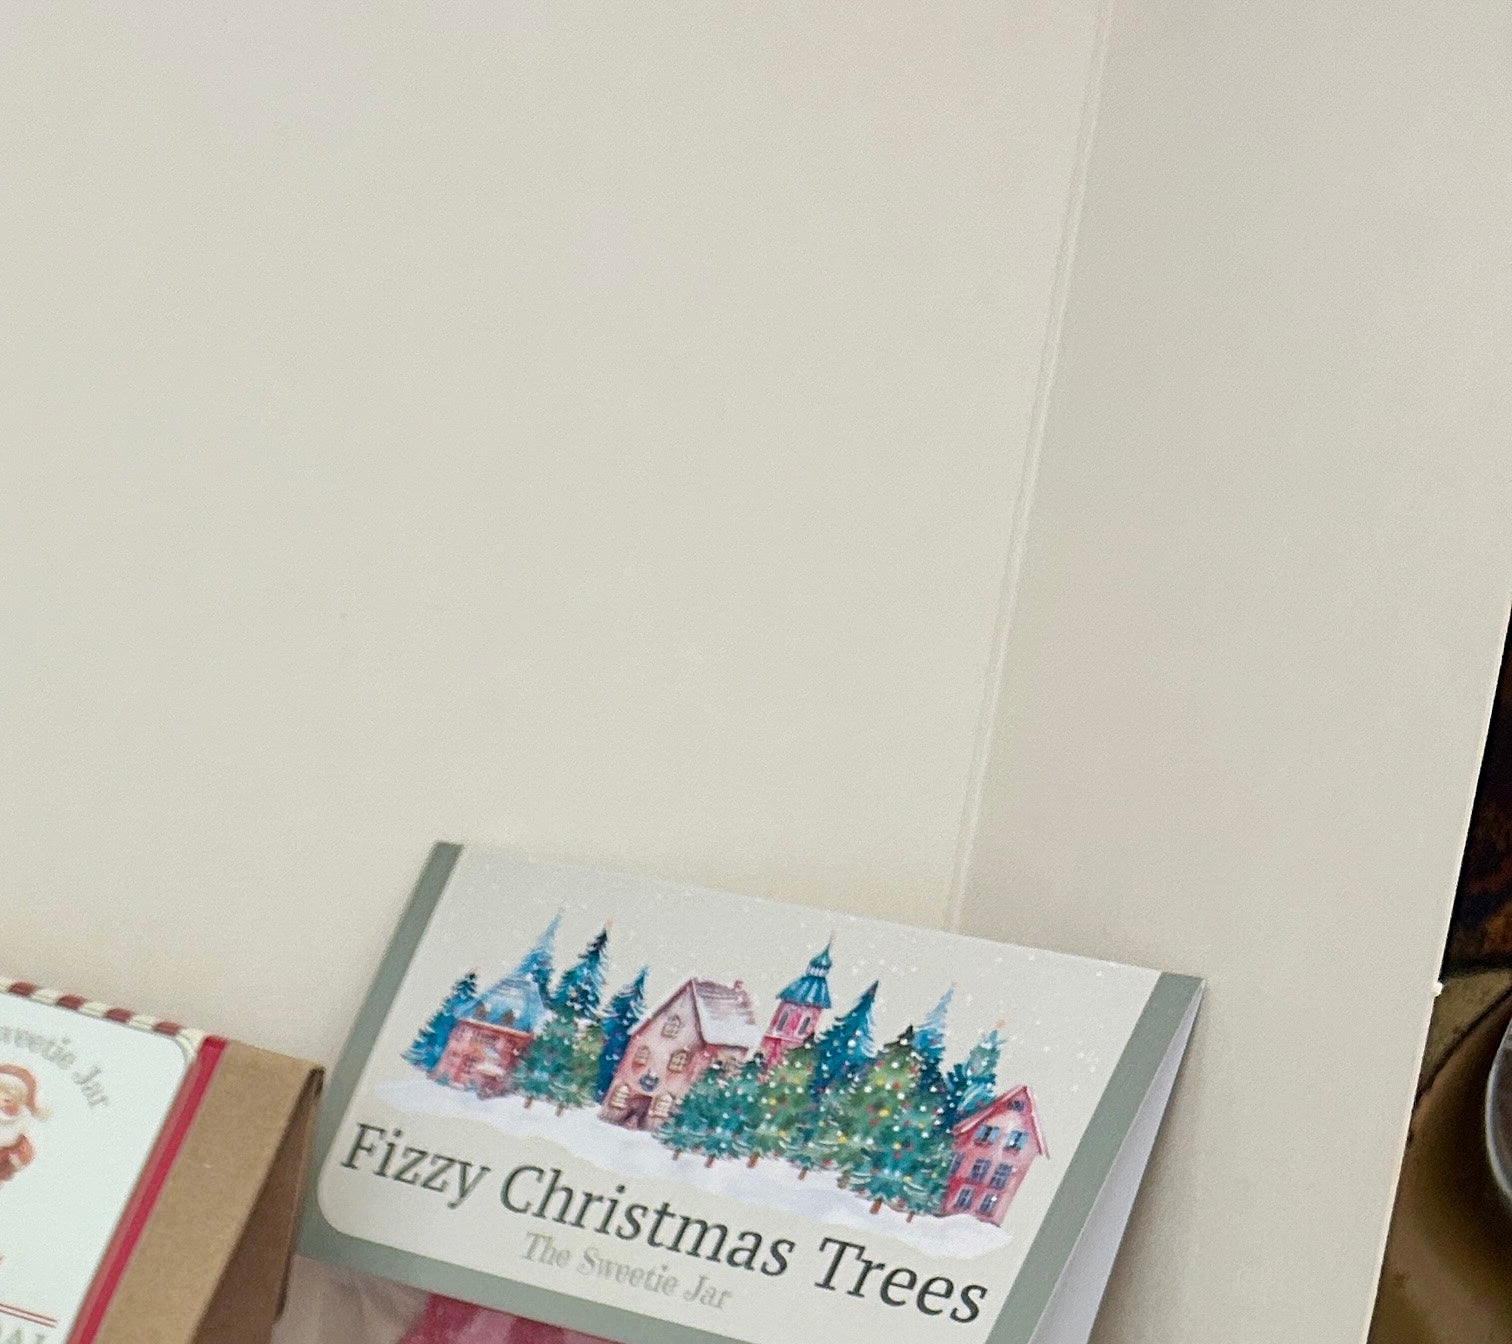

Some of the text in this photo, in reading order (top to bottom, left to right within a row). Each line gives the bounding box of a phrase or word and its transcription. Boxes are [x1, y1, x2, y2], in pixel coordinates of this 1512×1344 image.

[74, 1063, 111, 1109] Jar
[339, 1121, 989, 1325] Fizzy Christmas Trees
[519, 1231, 733, 1312] The Sweetie Jar
